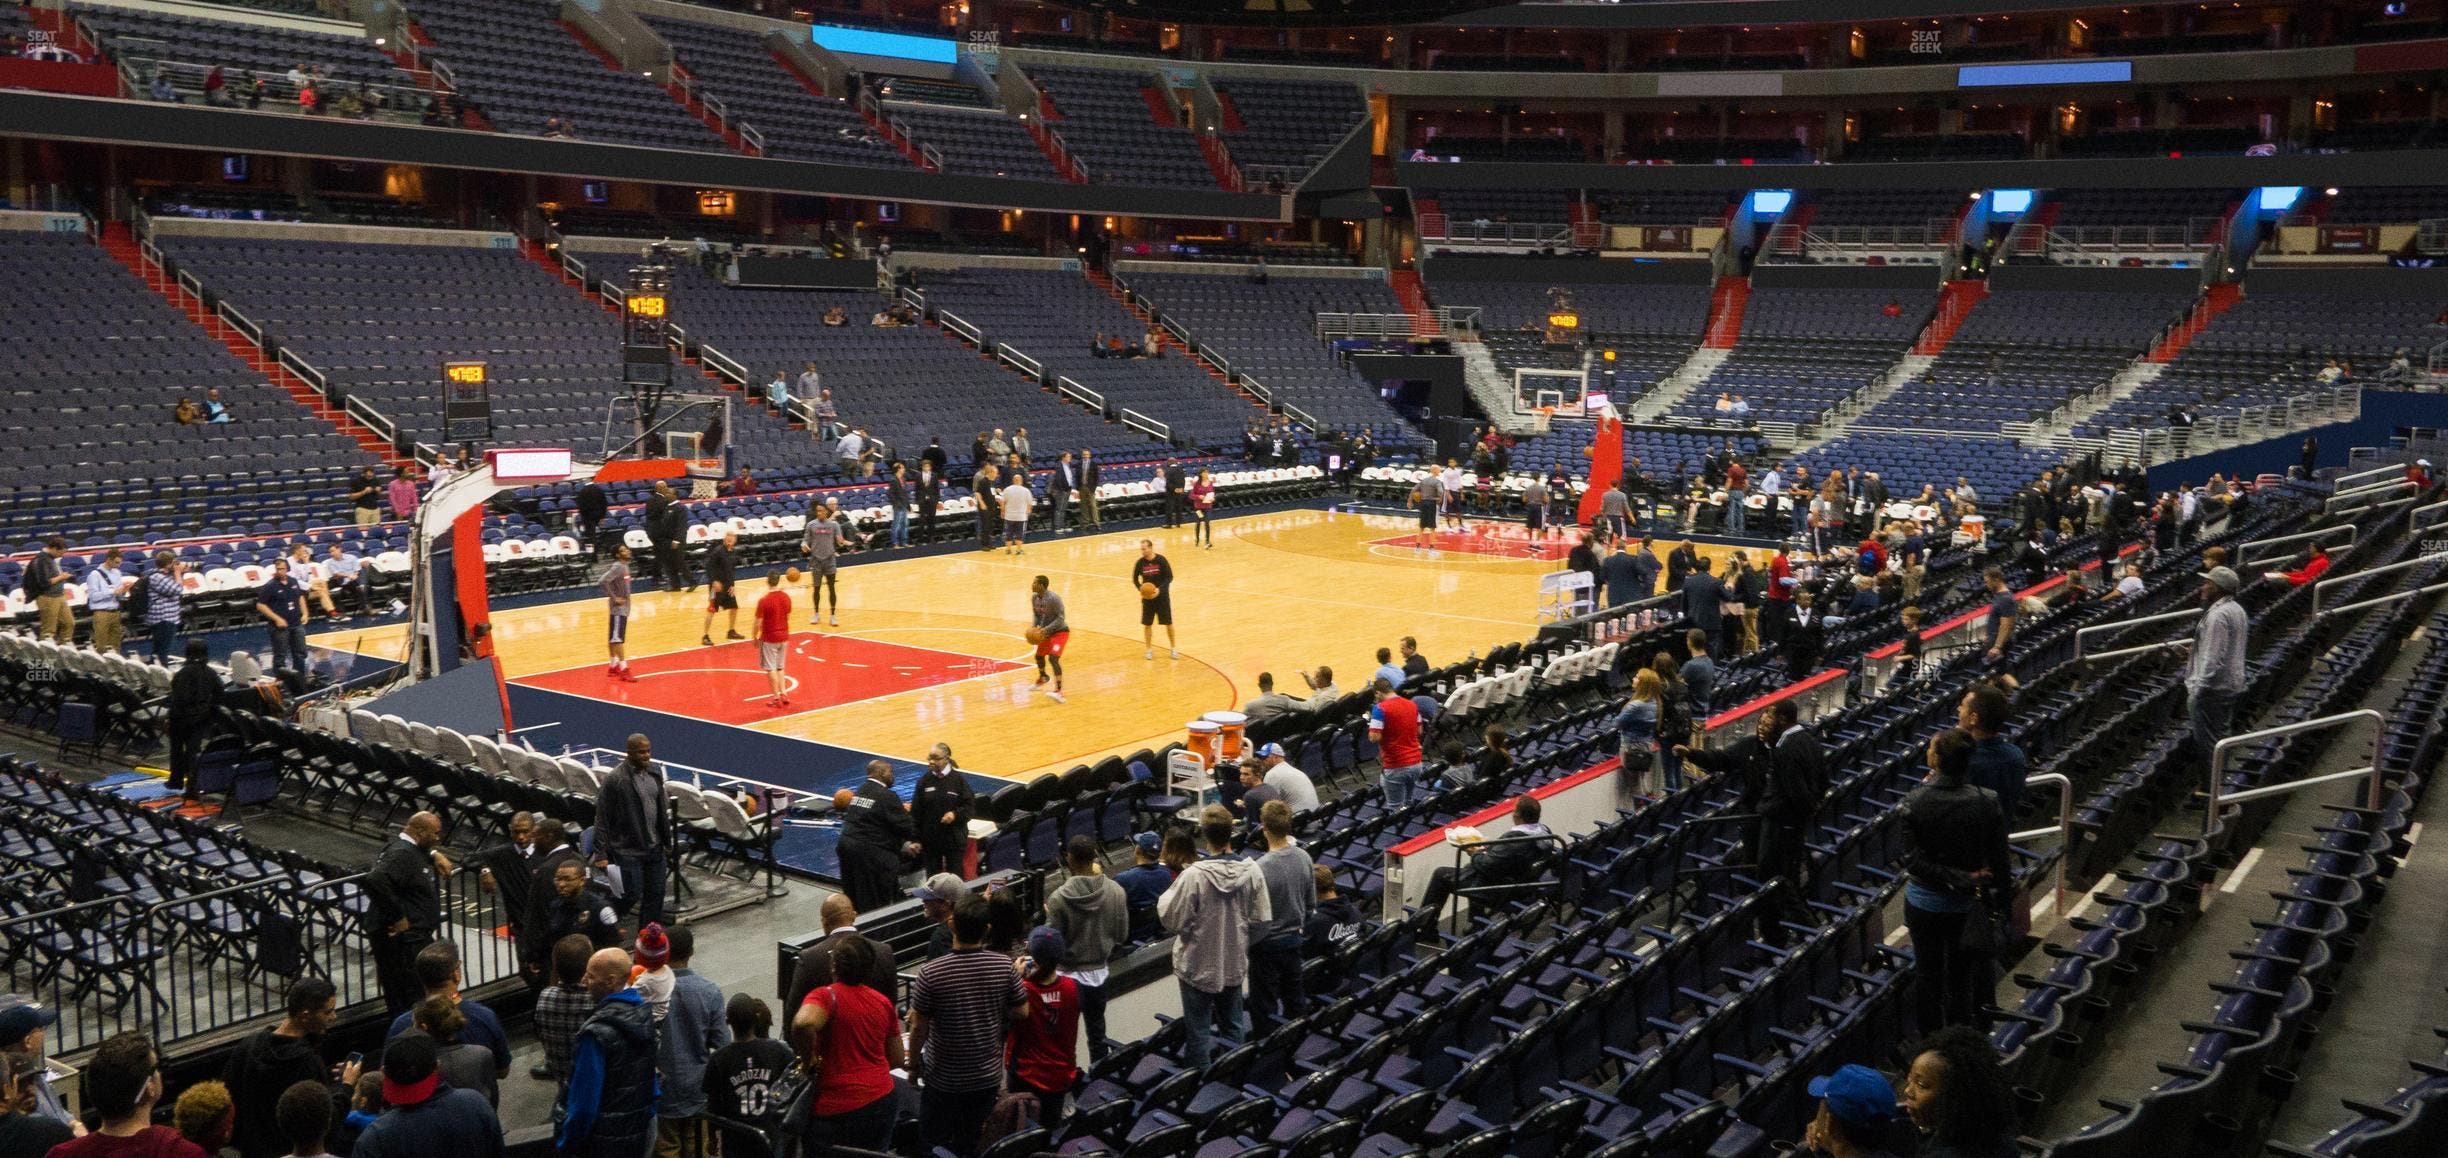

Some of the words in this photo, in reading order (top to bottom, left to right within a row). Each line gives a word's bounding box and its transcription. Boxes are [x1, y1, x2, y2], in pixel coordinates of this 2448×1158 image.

[52, 219, 78, 232] 112
[629, 296, 665, 315] 47:03
[448, 366, 484, 382] 47:03
[735, 1083, 769, 1116] 10
